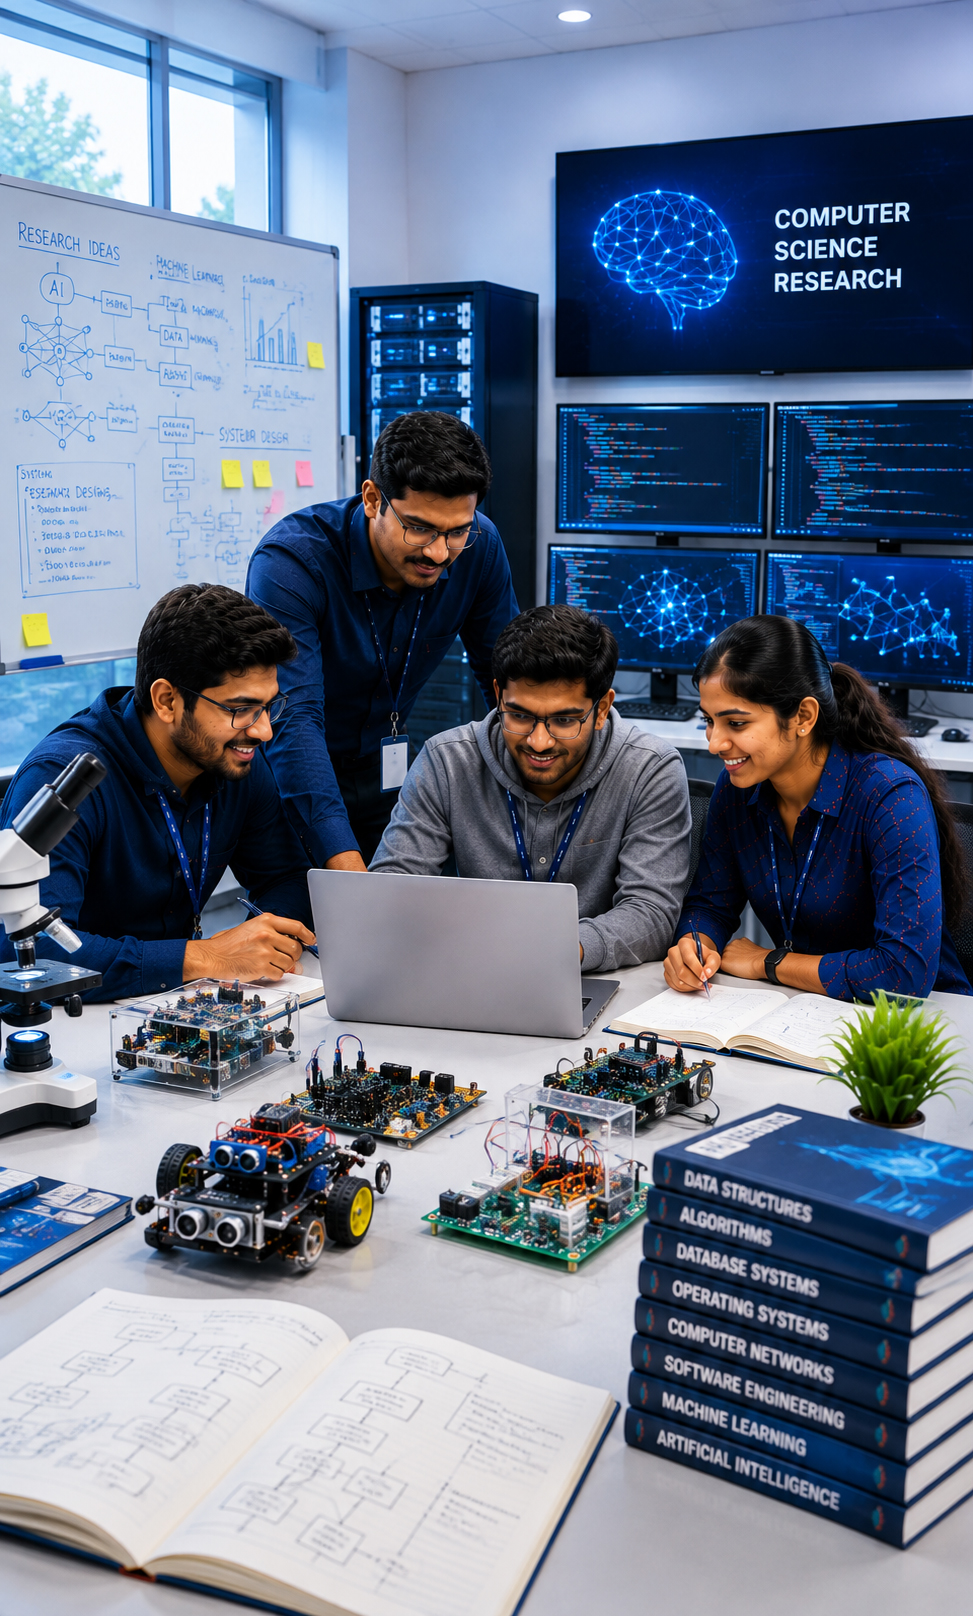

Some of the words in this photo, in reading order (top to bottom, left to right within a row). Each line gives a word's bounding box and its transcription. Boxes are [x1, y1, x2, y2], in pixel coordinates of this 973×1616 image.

[18, 221, 81, 252] RESEARCH
[88, 239, 121, 261] IDEAS
[774, 201, 910, 229] COMPUTER
[774, 236, 878, 260] SCIENCE
[49, 279, 64, 297] AI
[774, 267, 902, 293] RESEARCH
[684, 1169, 718, 1195] DATA
[721, 1181, 813, 1223] STRUCTURES
[679, 1206, 773, 1247] ALGORITHMS
[676, 1242, 748, 1277] DATABASE
[750, 1263, 820, 1298] SYSTEMS
[672, 1279, 754, 1318] OPERATING
[757, 1303, 830, 1342] SYSTEMS
[667, 1316, 747, 1356] COMPUTER
[750, 1342, 835, 1385] NETWORKS
[664, 1355, 742, 1394] SOFTWARE
[744, 1379, 846, 1430] ENGINEERING
[662, 1391, 728, 1429] MACHINE
[731, 1415, 807, 1458] LEARNING
[656, 1429, 732, 1469] ARTIFICIAL
[734, 1456, 841, 1511] INTELLIGENCE
